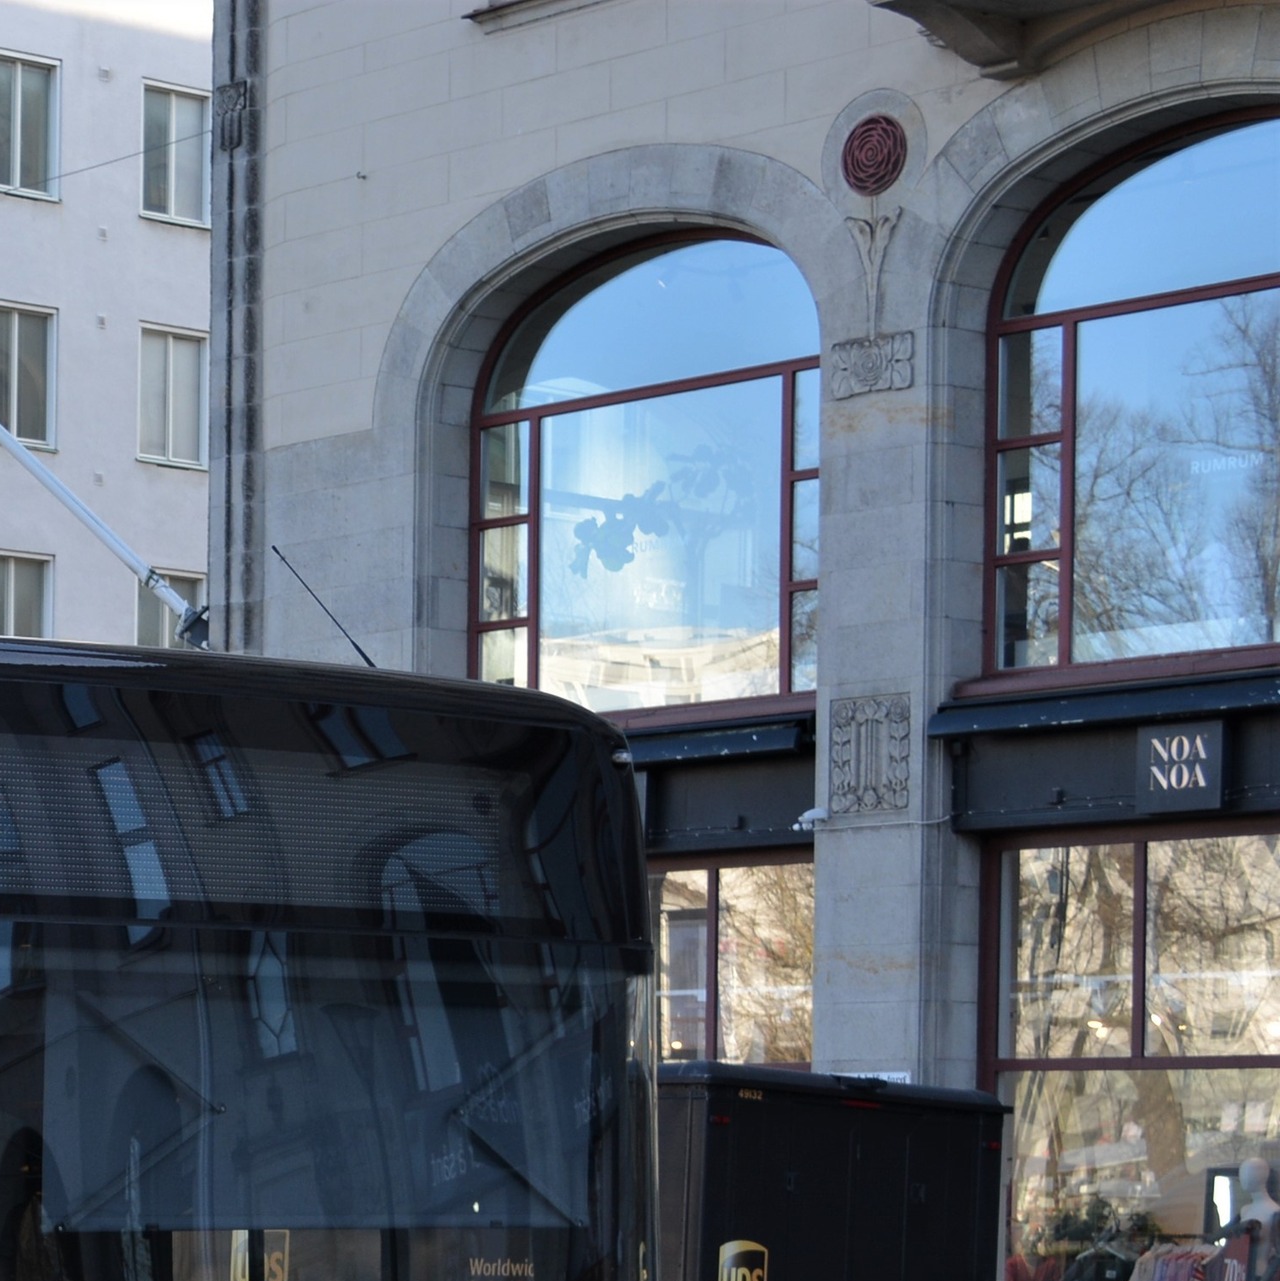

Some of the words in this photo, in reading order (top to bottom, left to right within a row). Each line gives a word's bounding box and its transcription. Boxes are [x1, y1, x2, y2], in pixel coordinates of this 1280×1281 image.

[1191, 452, 1264, 474] RUMRUM
[1150, 734, 1207, 763] NOA
[1149, 762, 1207, 791] NOA
